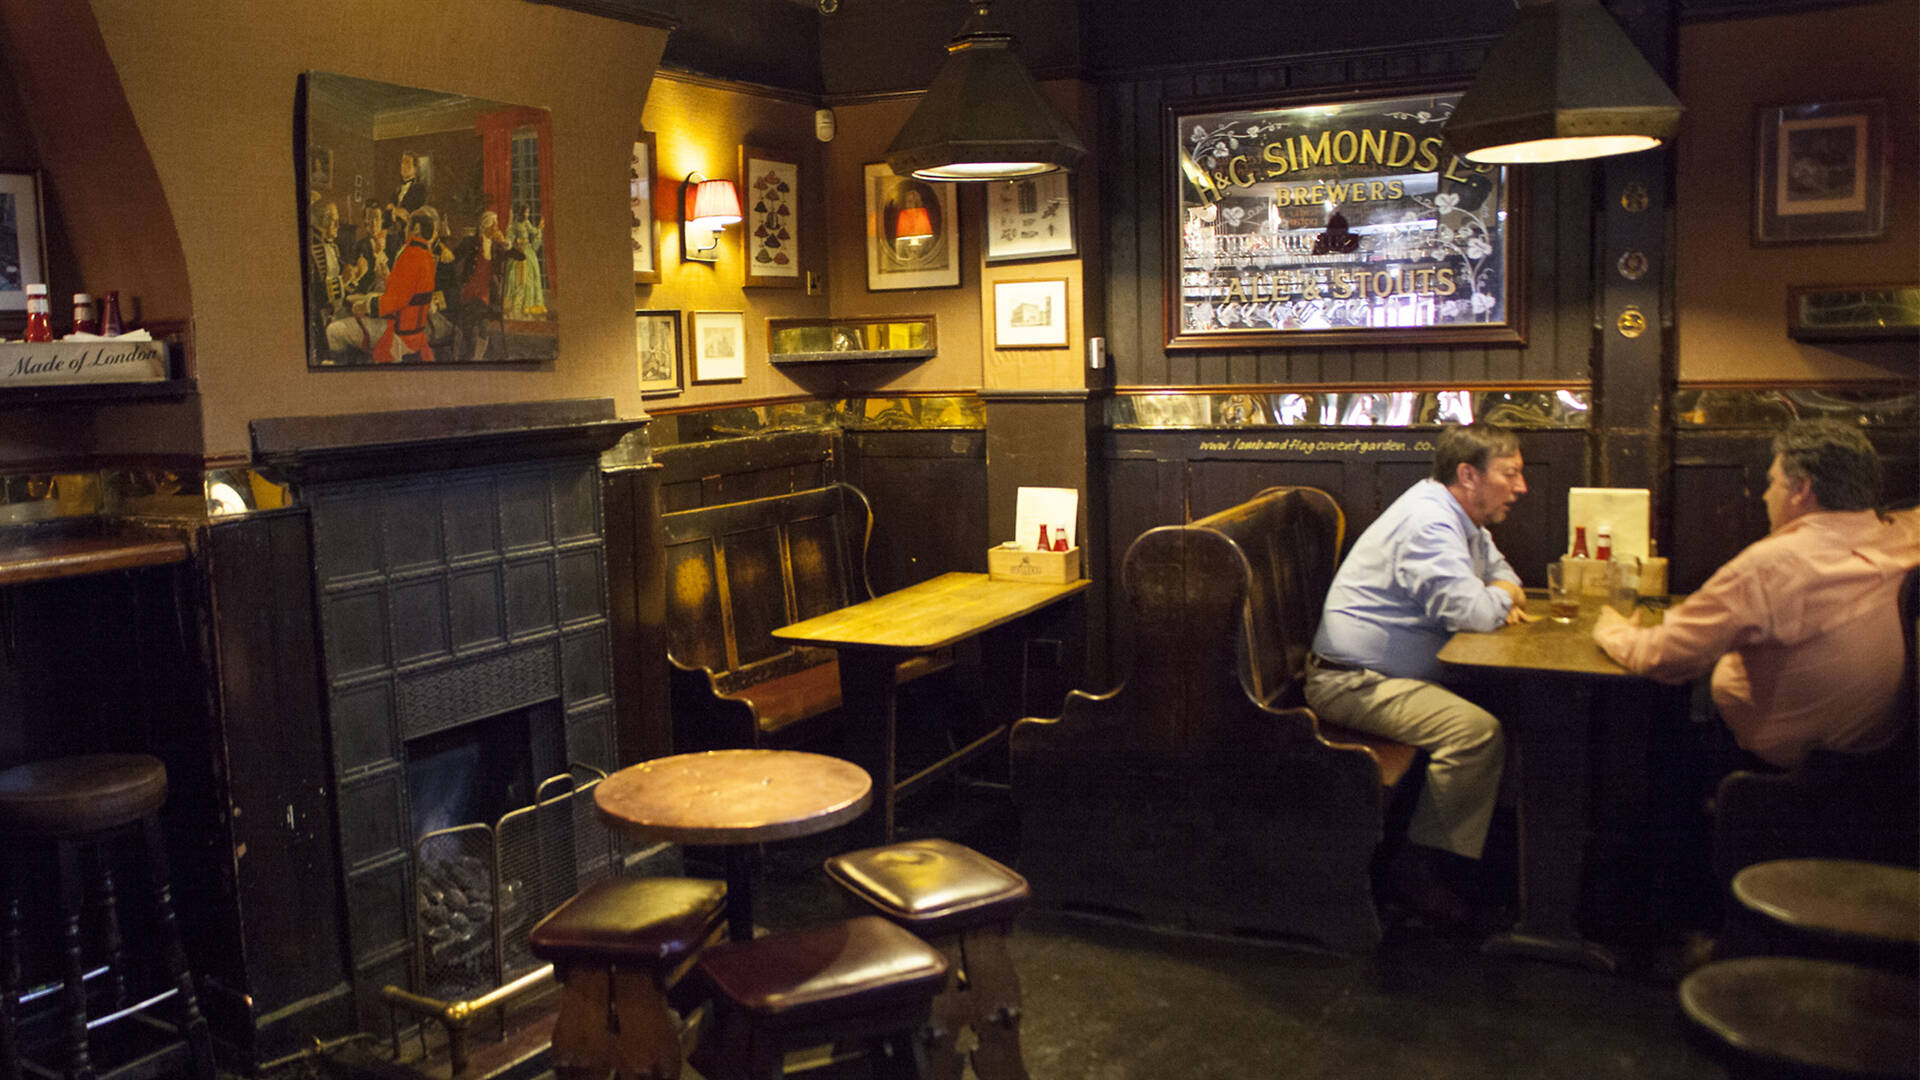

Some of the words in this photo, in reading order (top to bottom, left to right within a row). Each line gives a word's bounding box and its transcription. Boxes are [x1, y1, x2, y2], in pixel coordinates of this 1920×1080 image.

[1263, 129, 1443, 178] SIMONDS
[1275, 180, 1404, 207] BREWERS
[1224, 276, 1291, 304] ALE
[1303, 278, 1321, 300] &
[1332, 269, 1457, 300] STOUTS
[9, 354, 65, 377] Made
[68, 351, 88, 374] of
[91, 344, 157, 367] London
